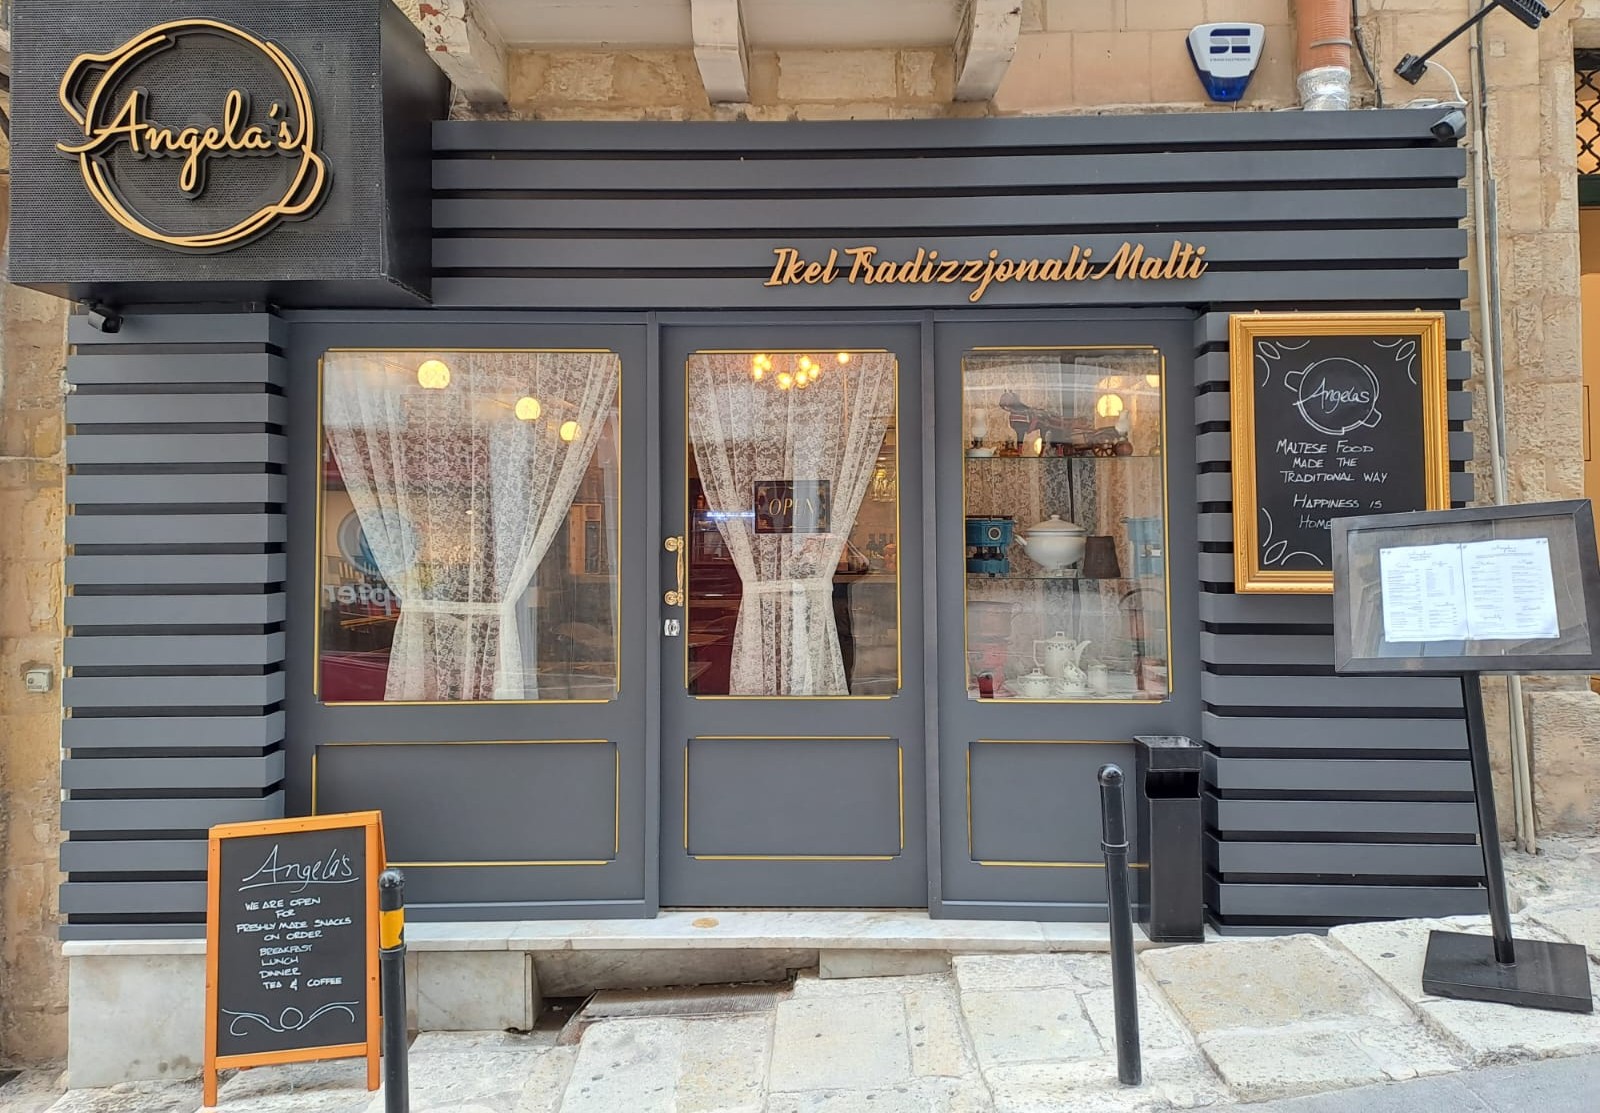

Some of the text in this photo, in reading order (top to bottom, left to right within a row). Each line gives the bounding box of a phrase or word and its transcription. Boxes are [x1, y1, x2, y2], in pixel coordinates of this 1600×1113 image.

[57, 89, 301, 192] Angela's
[763, 240, 1209, 303] Ikel Tradizzjonali Malti
[1276, 438, 1374, 455] MALTESE FOOD
[1292, 457, 1359, 468] MADE THE
[1279, 470, 1388, 484] TRADITIONAL WAY
[769, 498, 814, 516] OPEN
[1293, 493, 1382, 509] HAPPINESS IS
[241, 844, 353, 894] Angela's
[244, 896, 321, 911] WE ARE OPEN
[275, 908, 296, 919] FOR
[236, 916, 352, 933] FRESHLY MADE SNACKS
[263, 930, 323, 941] ON ORDER
[259, 943, 313, 956] BREAKFAST
[261, 955, 299, 966] LUNCH
[259, 967, 301, 979] DINNER
[263, 976, 343, 991] TEA & COFFEE
